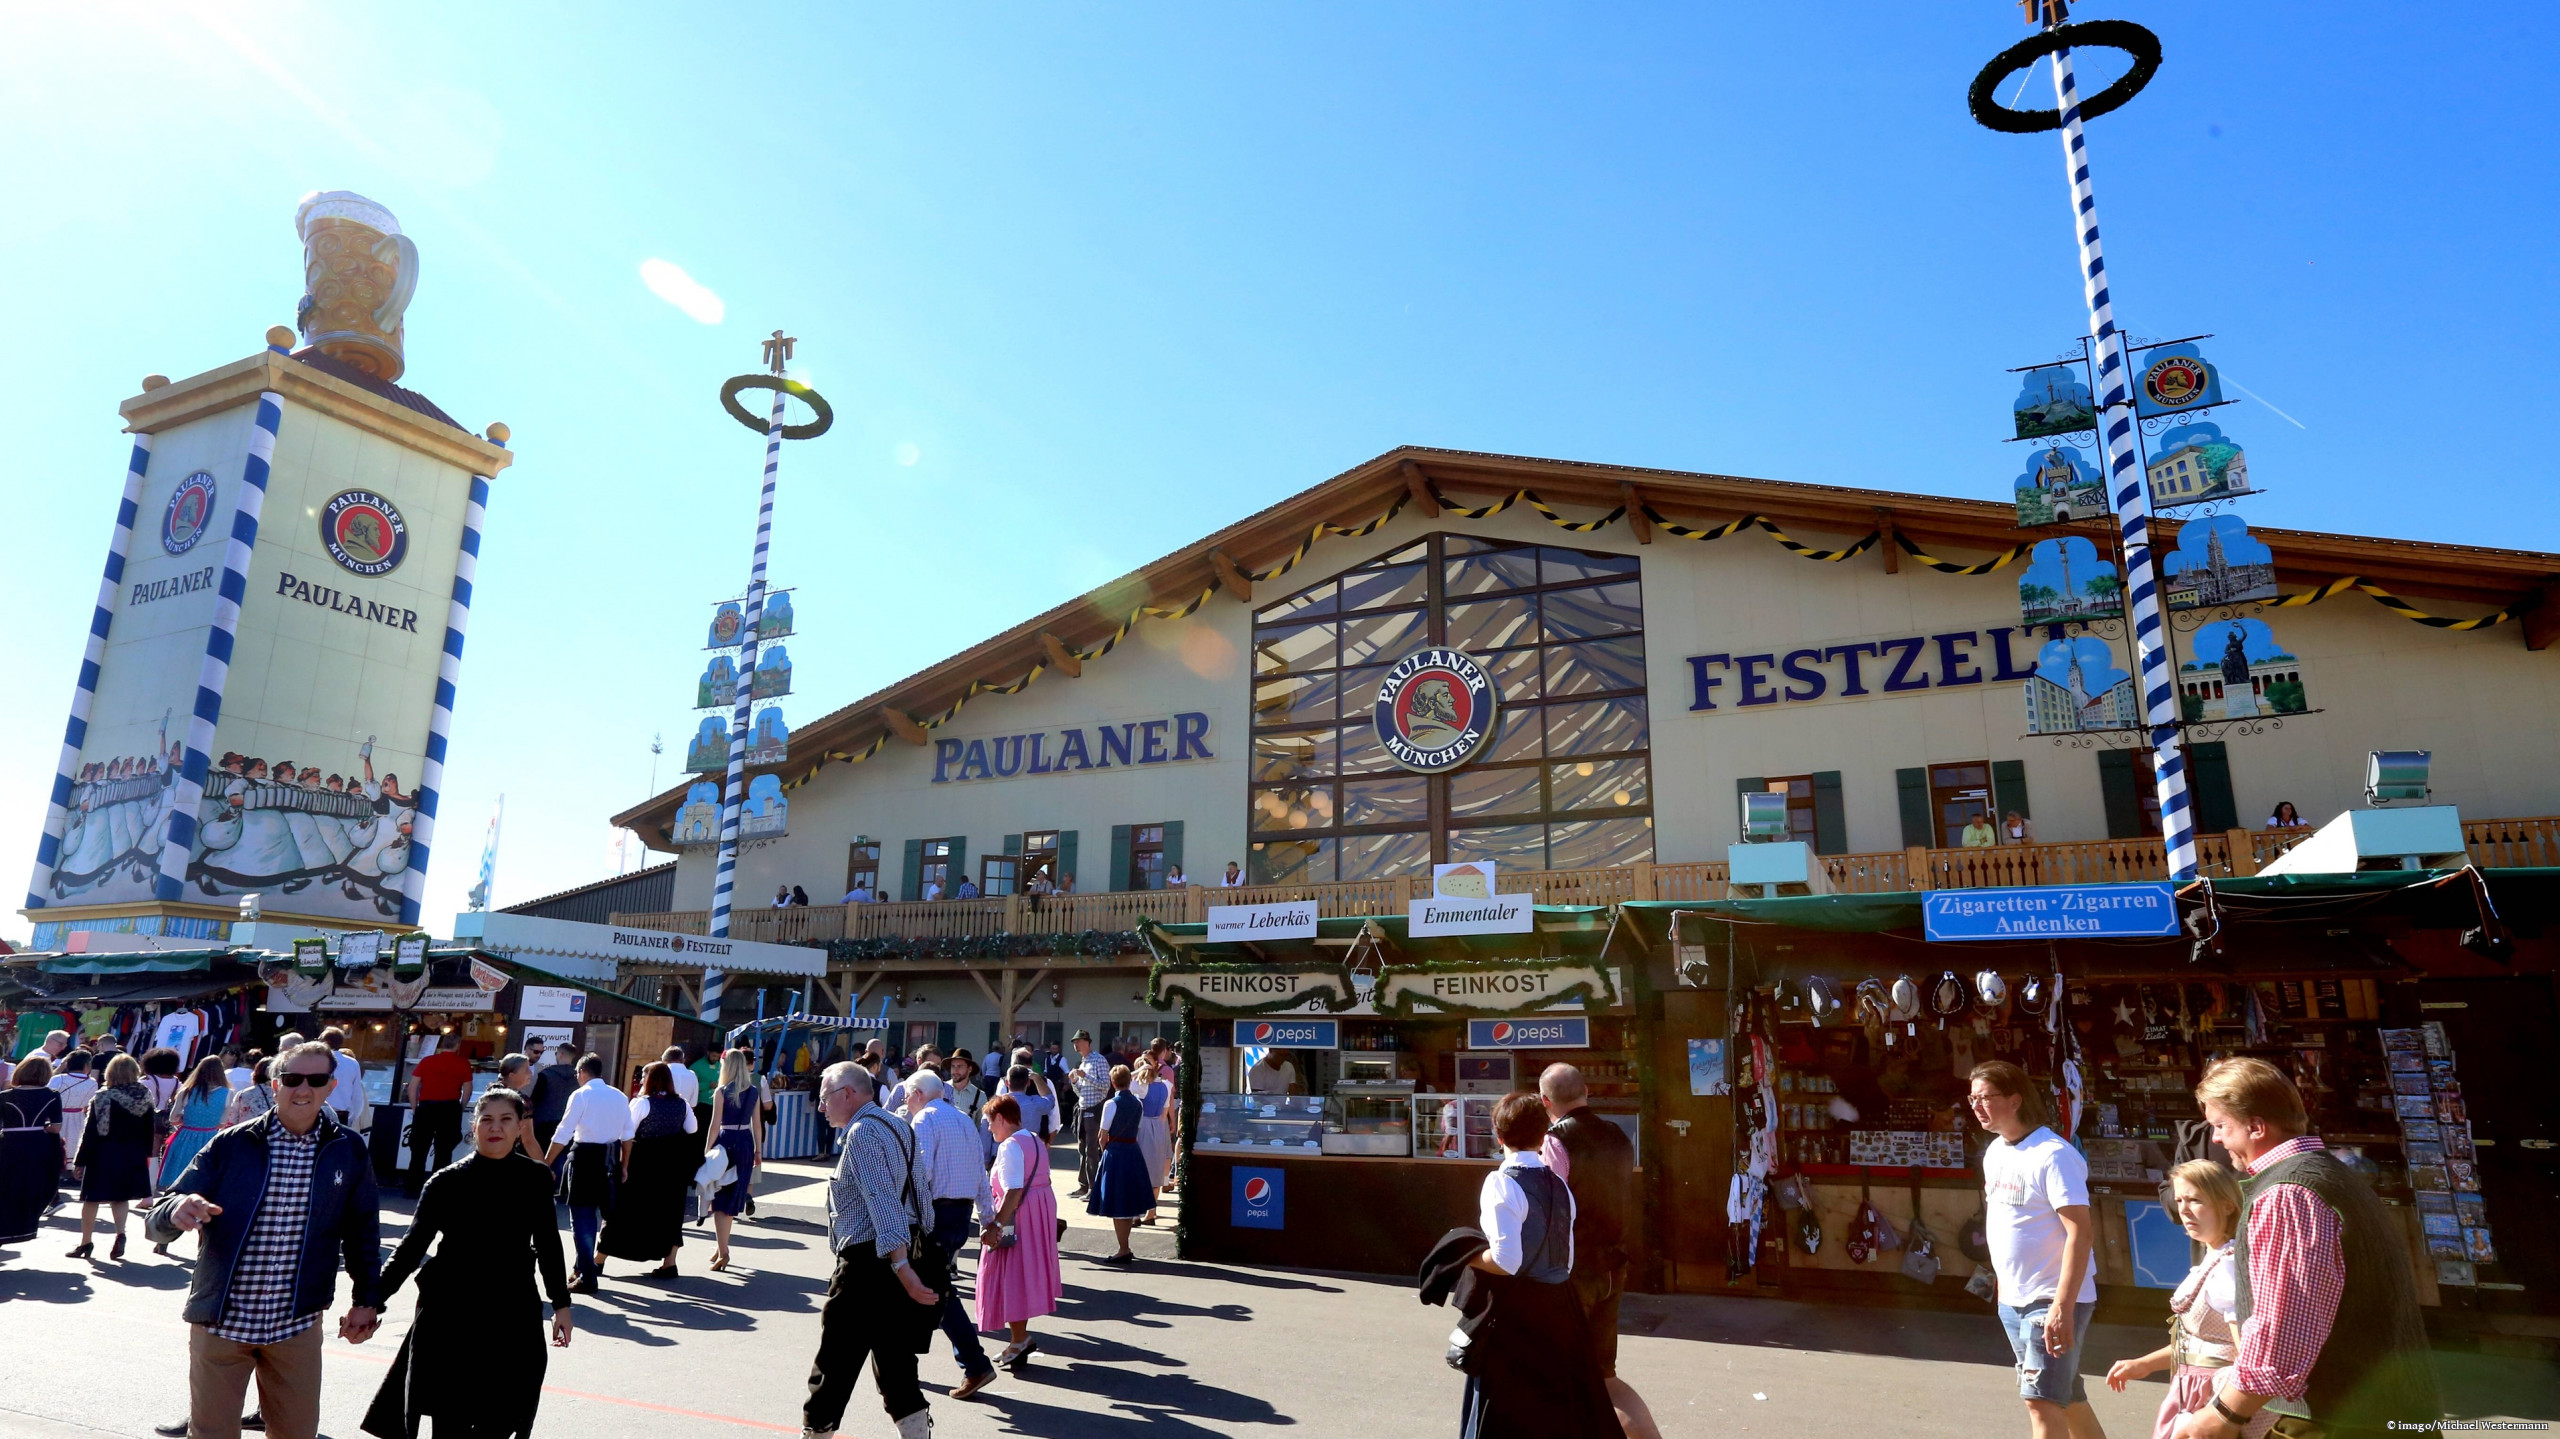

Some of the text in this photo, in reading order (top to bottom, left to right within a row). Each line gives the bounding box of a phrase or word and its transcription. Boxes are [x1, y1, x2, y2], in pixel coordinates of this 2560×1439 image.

[2147, 359, 2202, 382] PAULANER
[169, 472, 216, 509] PAULANER
[328, 492, 404, 535] PAULANER
[328, 541, 392, 574] MÜNCHEN
[129, 566, 214, 606] PAULANER
[276, 571, 419, 634] PAULANER
[1378, 650, 1486, 705] PAULANER
[931, 710, 1214, 784] PAULANER
[1385, 727, 1480, 766] MÜNCHEN
[1424, 903, 1519, 924] Emmentaler
[1938, 893, 2158, 916] Zigaretten Zigarren
[1215, 910, 1310, 930] warmer Leberkäs
[1995, 914, 2101, 933] Andenken
[613, 931, 670, 950] PAULANER
[686, 939, 733, 956] FESTZELT
[1199, 976, 1300, 993] FEINKOST
[1433, 973, 1549, 995] FEINKOST
[1276, 1026, 1316, 1042] pepsi
[1517, 1024, 1563, 1042] pepsi
[1247, 1209, 1269, 1218] pepsi
